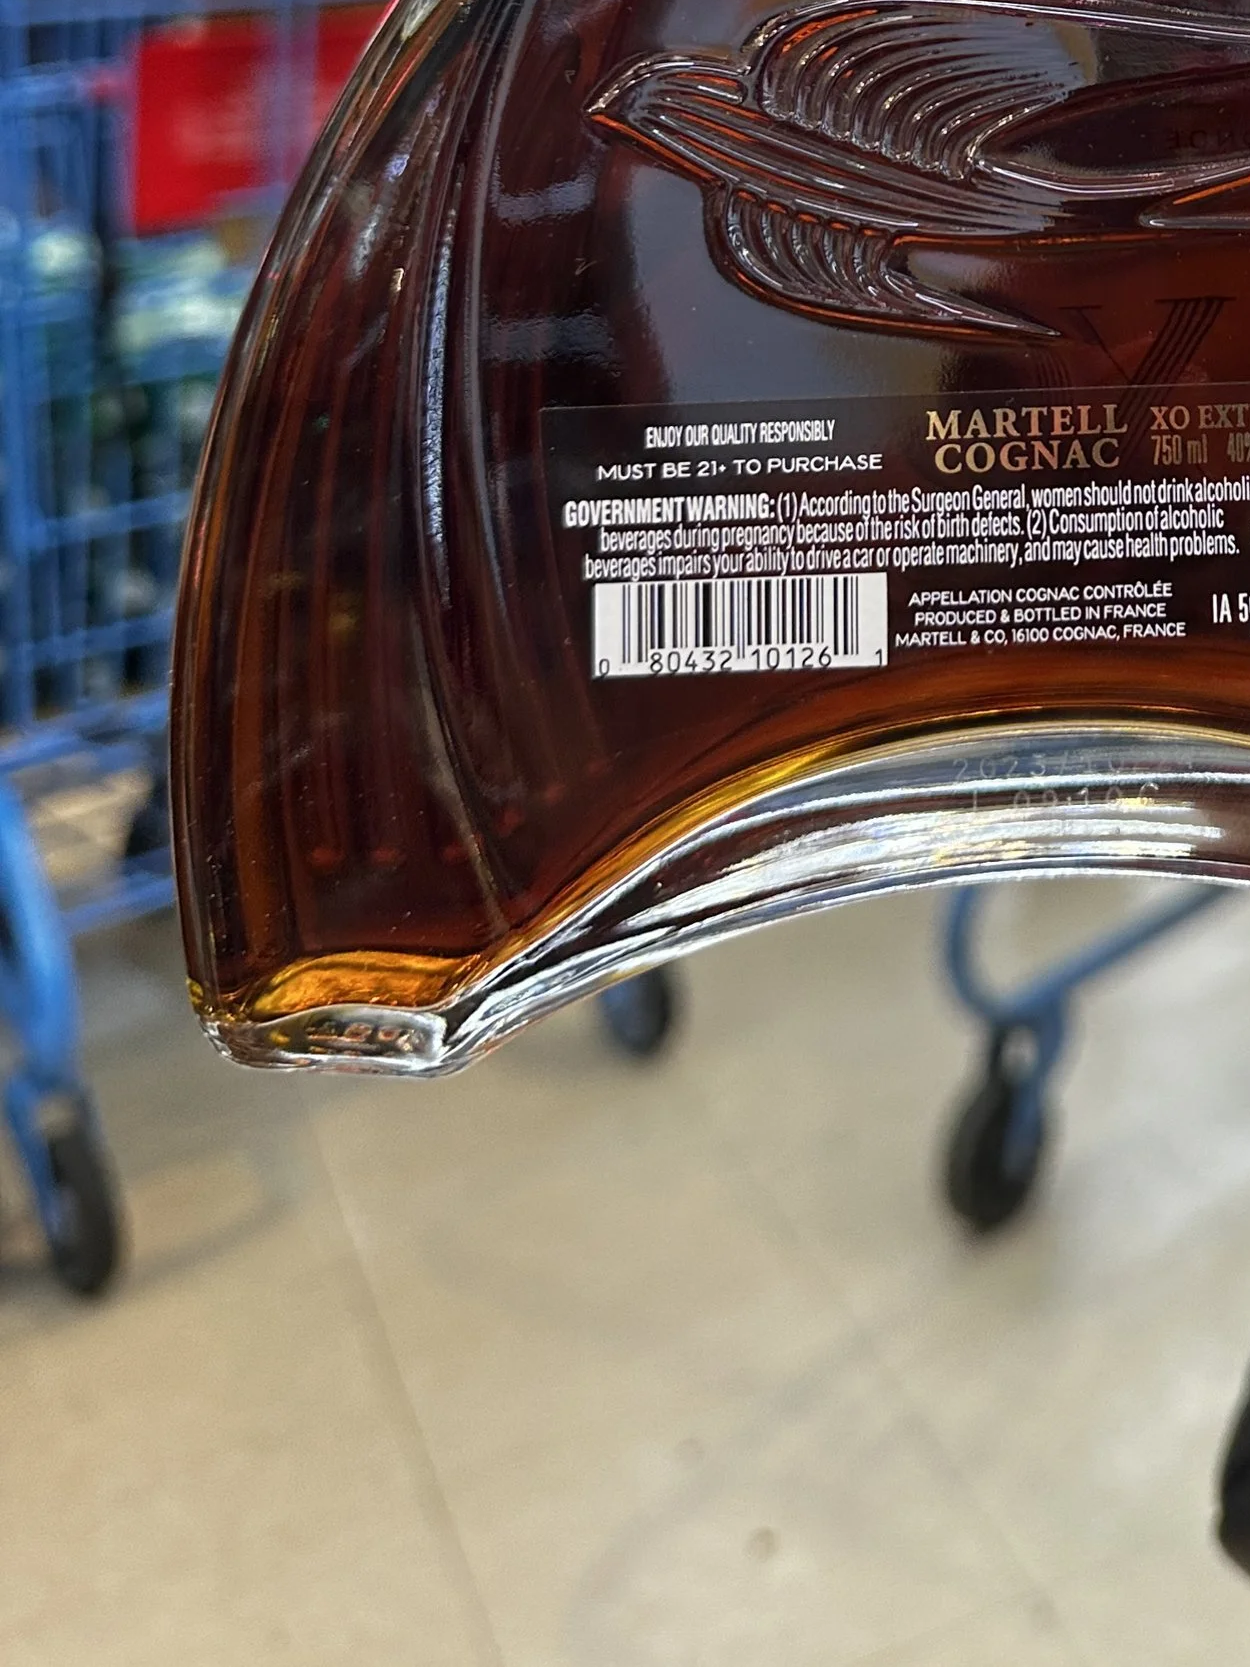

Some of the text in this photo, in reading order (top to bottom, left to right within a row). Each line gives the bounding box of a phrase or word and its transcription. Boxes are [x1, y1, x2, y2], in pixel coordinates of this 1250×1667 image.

[645, 419, 836, 448] ENJOY OUR QUALITY RESPONSIBLY
[926, 403, 1128, 441] MARTELL
[1150, 405, 1190, 431] XO
[934, 438, 1120, 474] COGNAC
[1151, 434, 1183, 466] 750
[1186, 434, 1208, 465] ml
[598, 453, 883, 481] MUST BE 21+ TO PURCHASE
[563, 496, 685, 528] GOVERNMENT
[687, 493, 775, 522] WARNING:
[777, 491, 798, 523] (1)
[799, 489, 871, 520] According
[872, 490, 887, 514] to
[888, 488, 910, 513] the
[911, 486, 970, 516] Surgeon
[972, 483, 1030, 512] General,
[1032, 486, 1082, 509] women
[1084, 479, 1131, 506] should
[1134, 480, 1156, 504] not
[1158, 477, 1195, 503] drink
[600, 503, 1224, 554] beverages during pregnancy because of the risk of birth defects. (2) Consumption of alcoholic
[584, 530, 1240, 581] beverages impairs your ability to drive a car or operate machinery, and may cause health problems.
[908, 580, 1173, 607] APPELLATION COGNAC CONTRÔLÉE
[1212, 592, 1232, 624] IA
[914, 603, 1167, 627] PRODUCED & BOTTLED IN FRANCE
[894, 631, 966, 648] MARTELL
[970, 630, 981, 645] &
[1011, 627, 1049, 643] 16100
[1055, 625, 1121, 642] COGNAC,
[1123, 622, 1186, 639] FRANCE
[599, 646, 884, 677] 0 80432 10126 1
